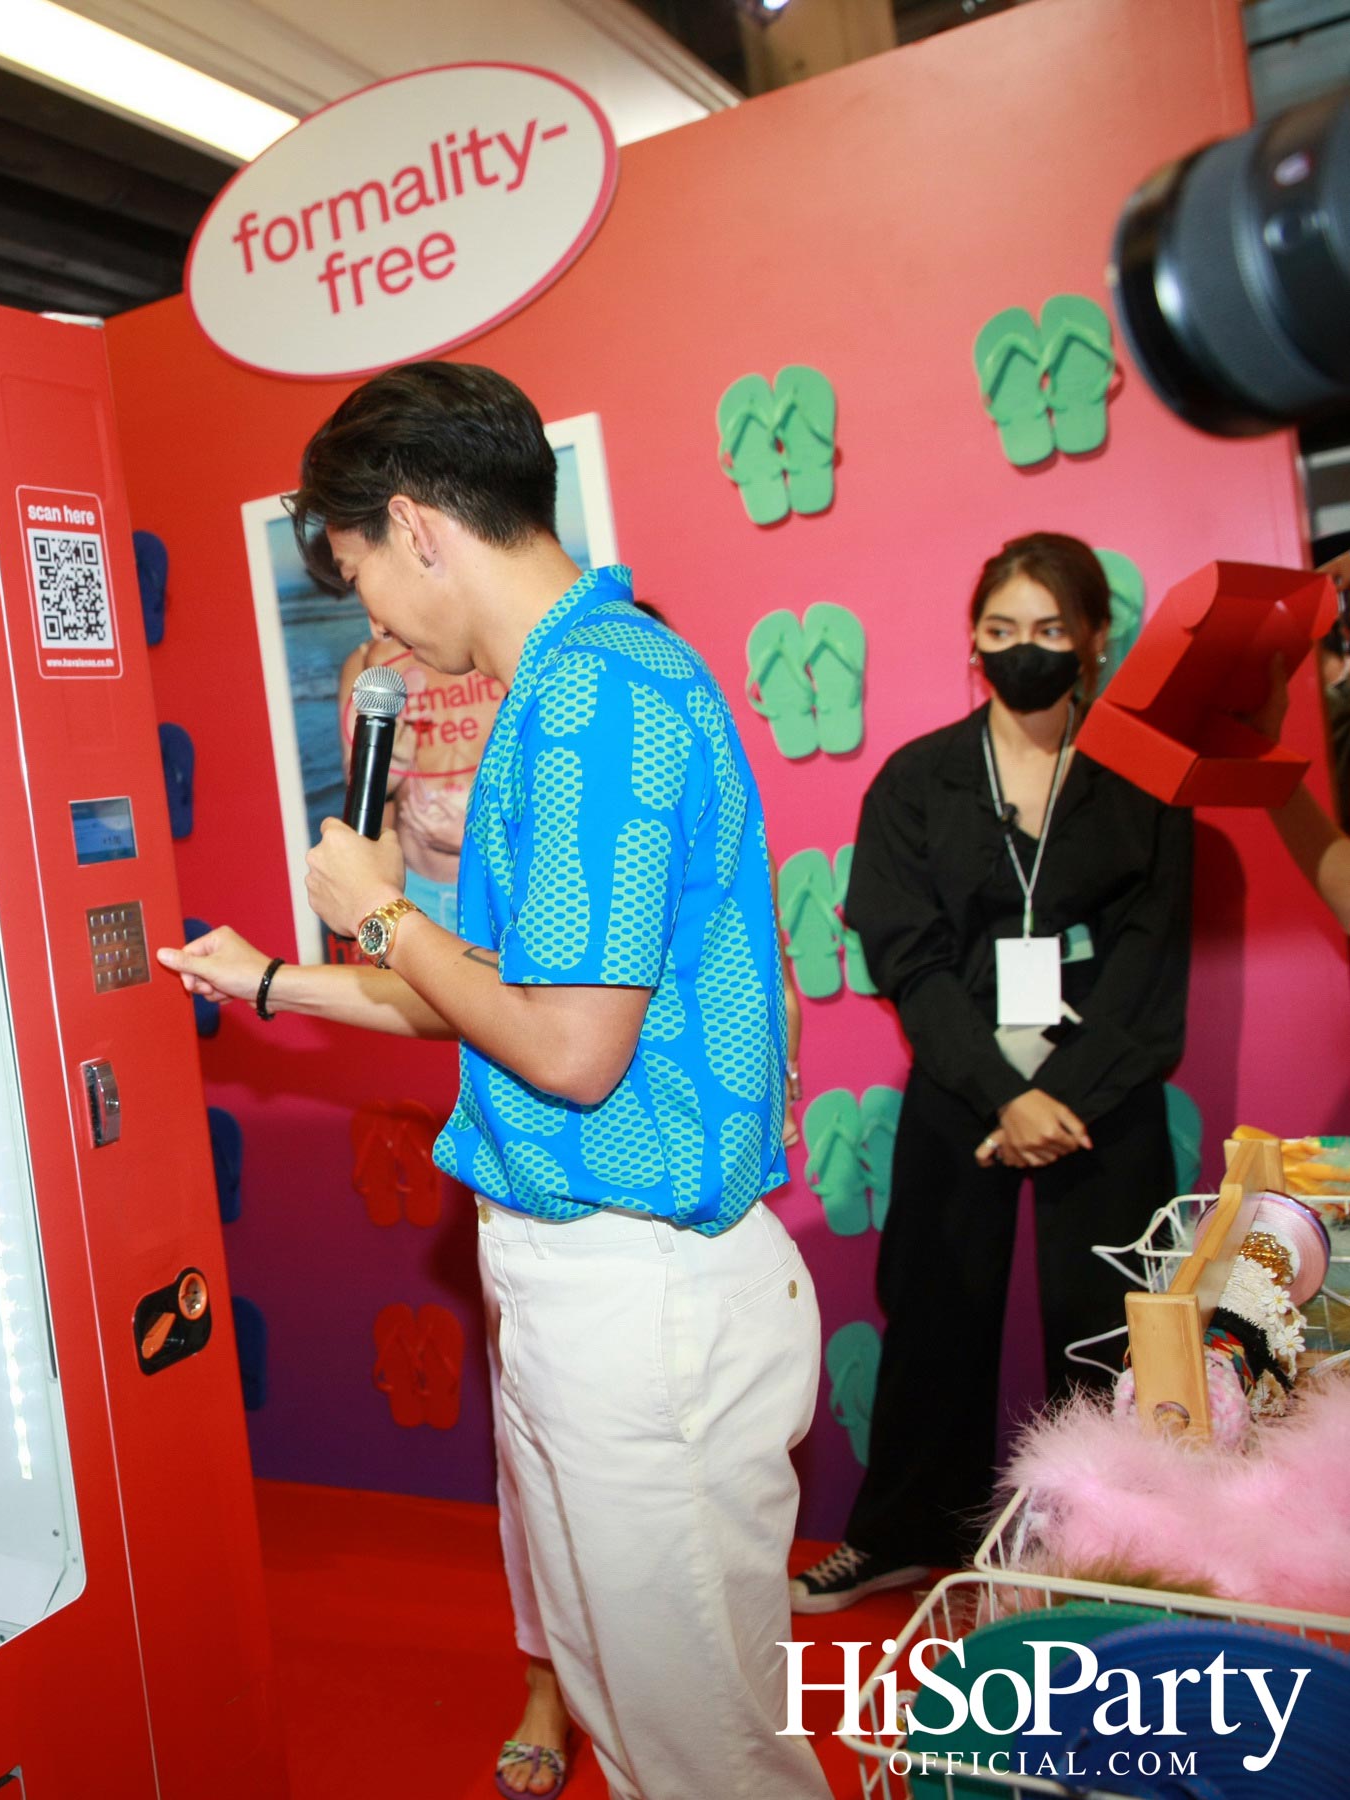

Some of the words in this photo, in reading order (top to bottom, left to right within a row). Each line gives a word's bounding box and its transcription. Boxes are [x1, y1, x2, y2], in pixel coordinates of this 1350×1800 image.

[232, 118, 568, 274] formality-
[318, 231, 457, 315] free
[28, 504, 61, 523] scan
[64, 505, 95, 526] here
